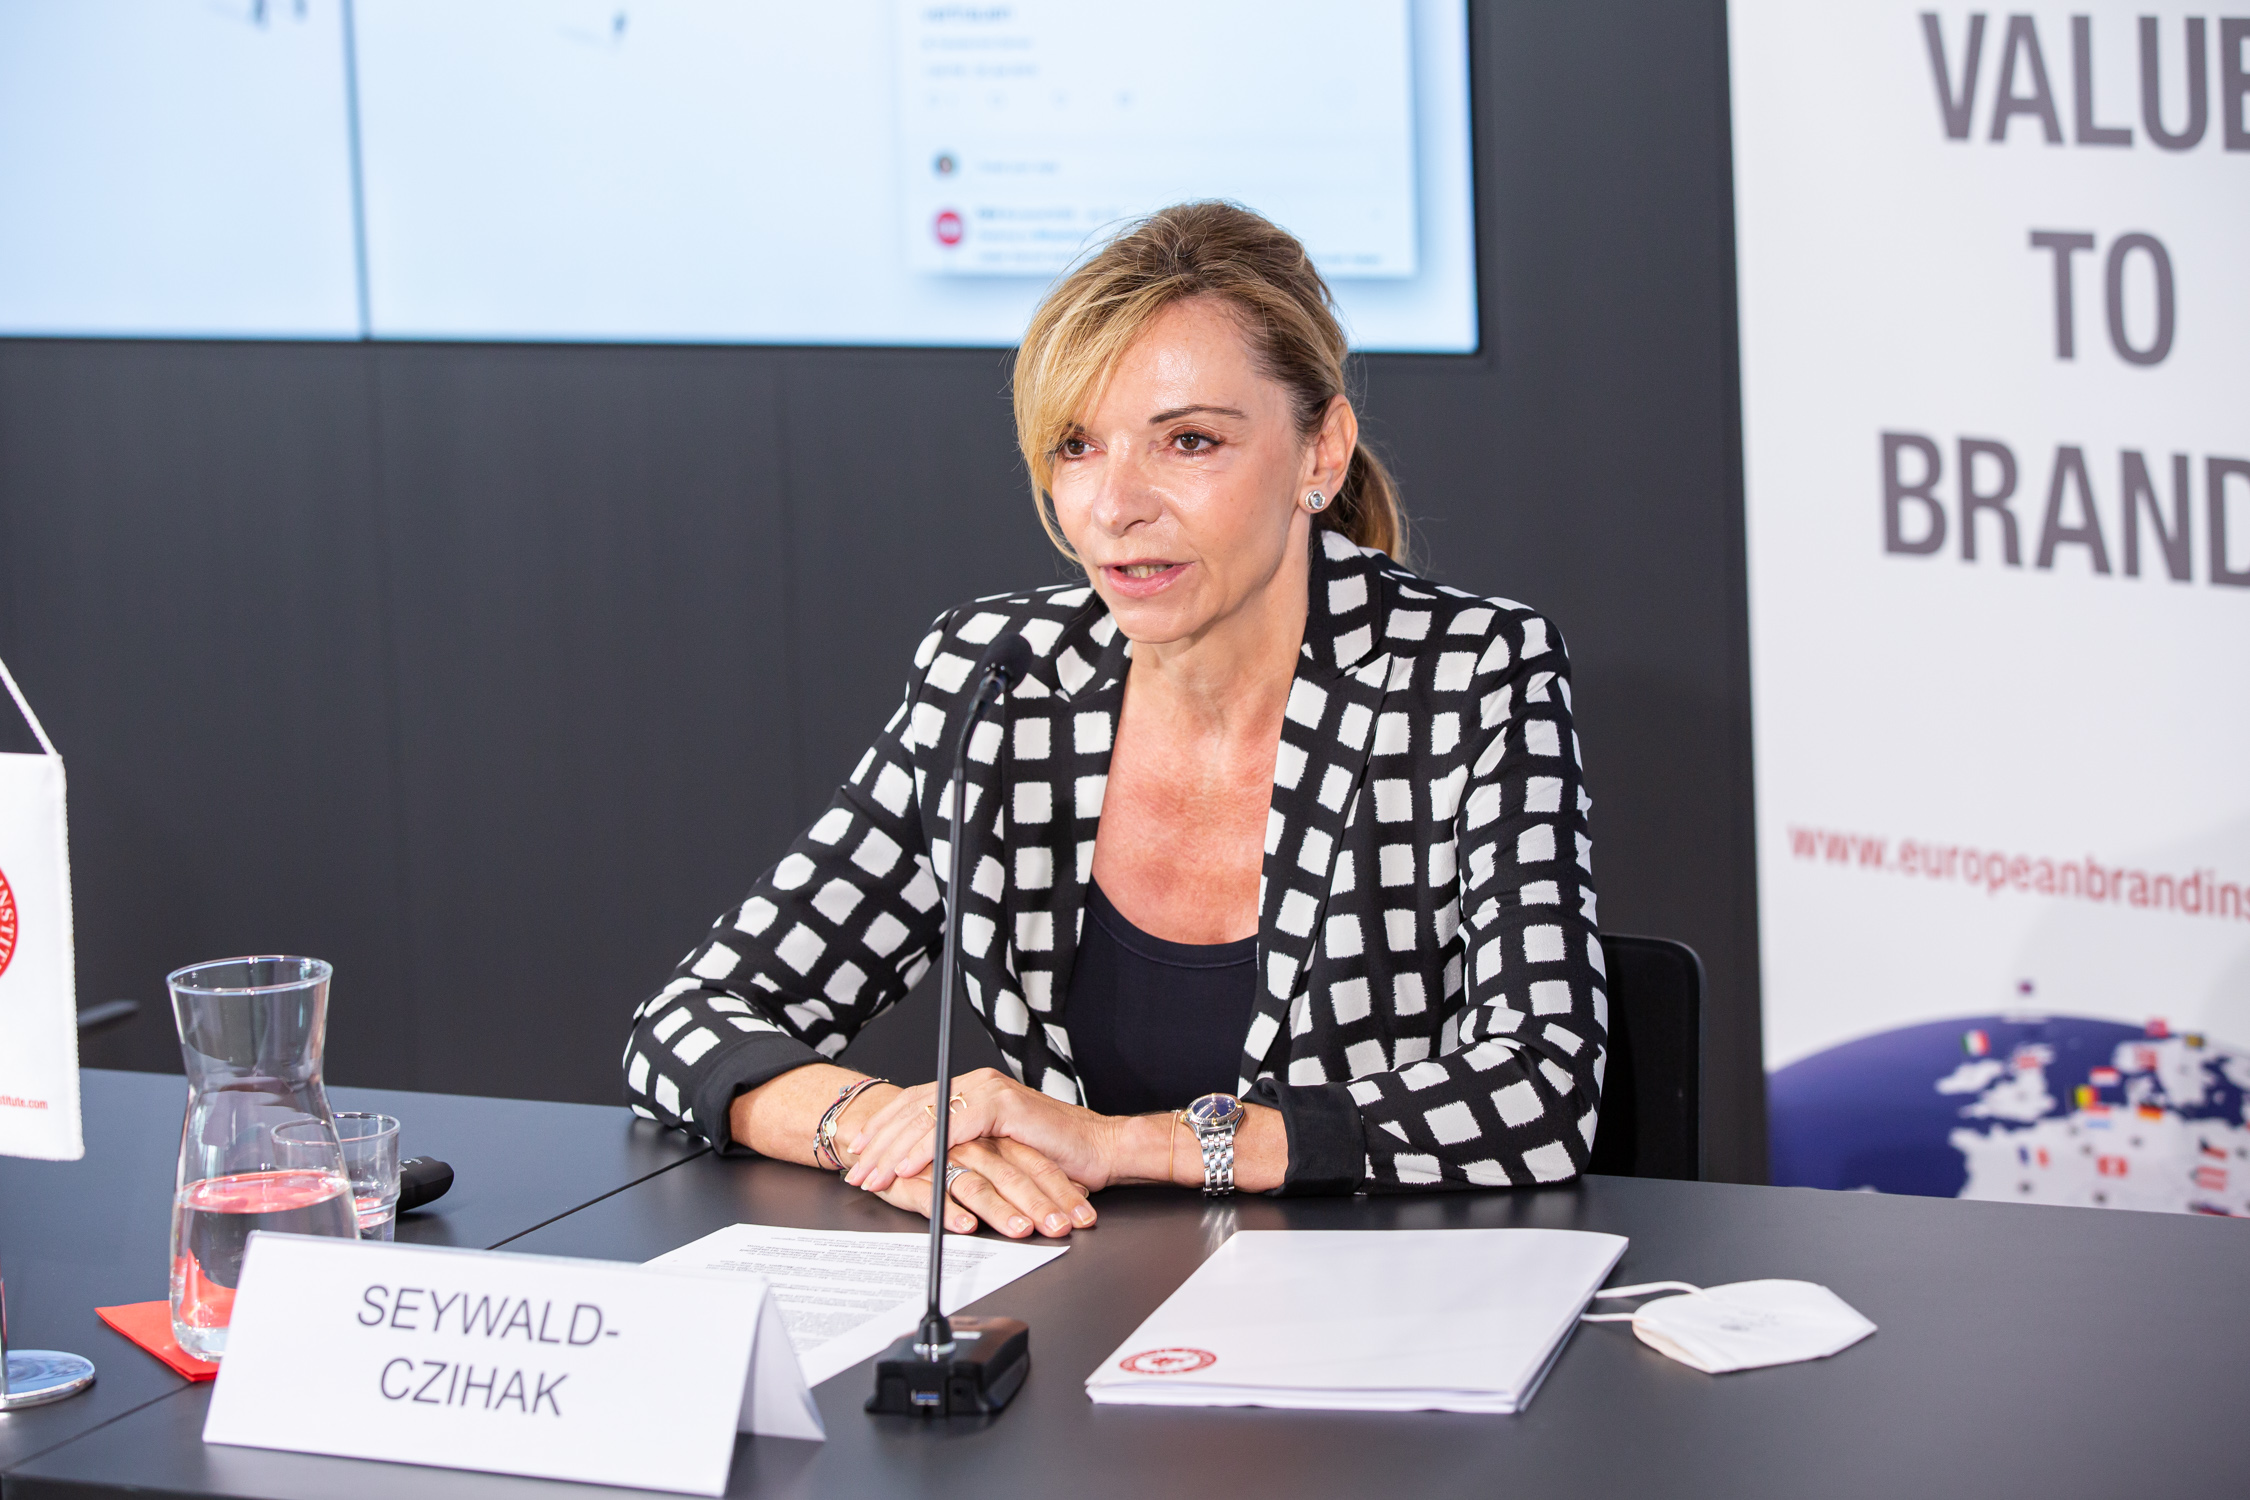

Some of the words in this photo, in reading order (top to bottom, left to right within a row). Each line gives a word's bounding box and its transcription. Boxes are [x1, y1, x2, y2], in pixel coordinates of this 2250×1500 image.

[1918, 10, 2250, 154] VALUE
[2028, 228, 2177, 367] TO
[1879, 428, 2250, 589] BRAND
[357, 1284, 621, 1347] SEYWALD-
[380, 1357, 569, 1417] CZIHAK
